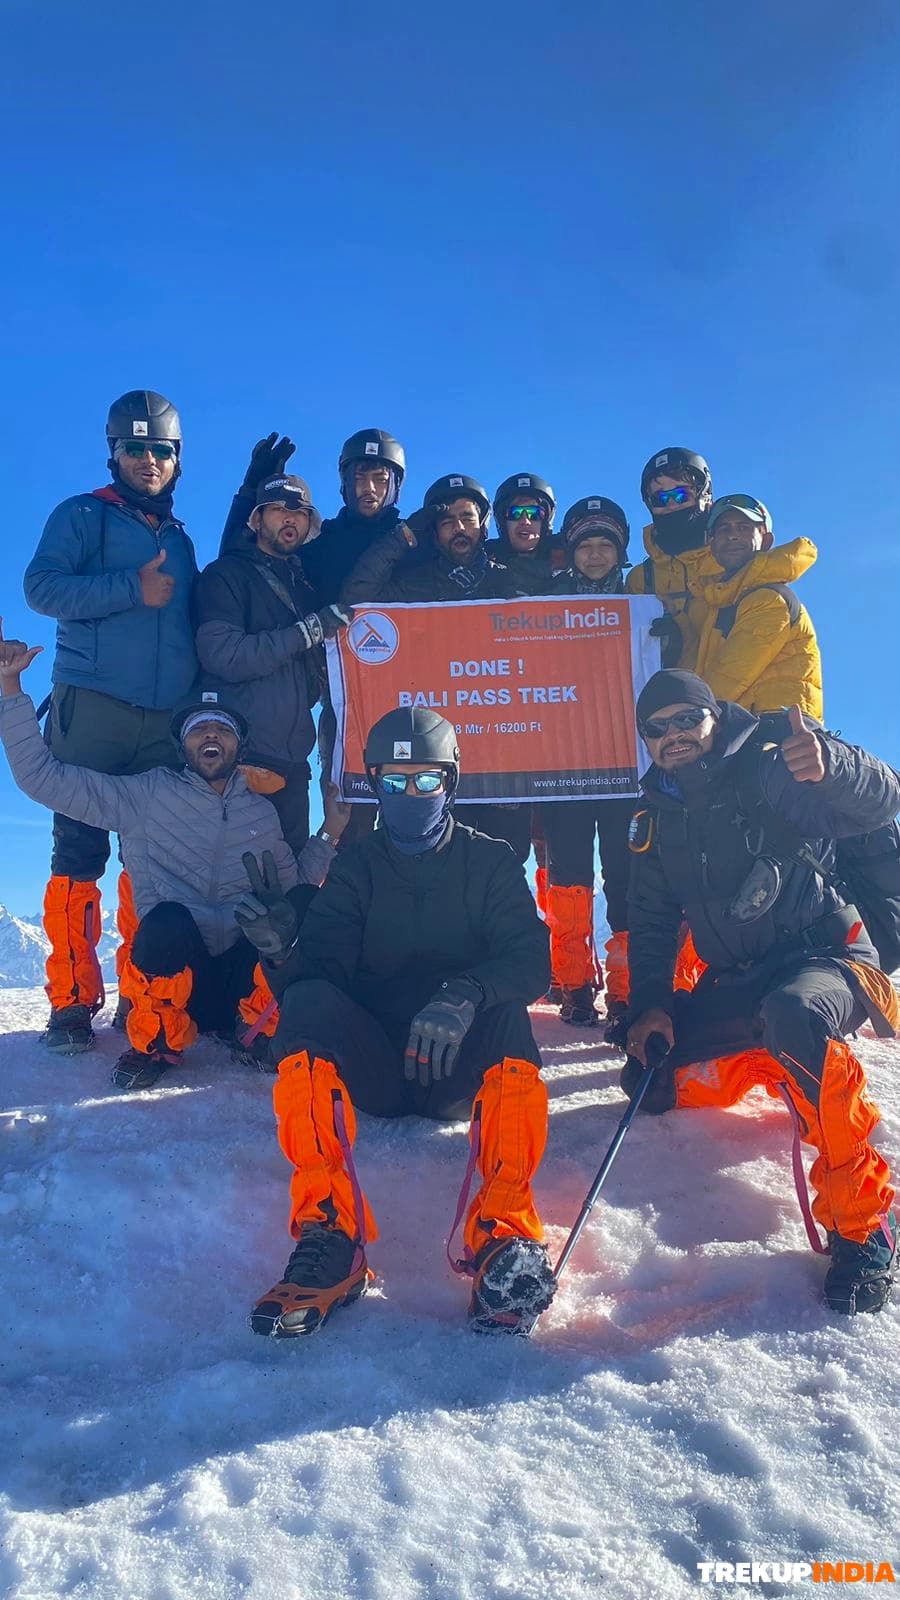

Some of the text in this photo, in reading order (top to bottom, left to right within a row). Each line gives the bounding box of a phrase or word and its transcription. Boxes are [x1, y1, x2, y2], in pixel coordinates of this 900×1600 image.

[488, 606, 620, 632] TrekupIndia
[450, 659, 525, 677] DONE !
[399, 685, 578, 708] BALI PASS TREK
[455, 721, 542, 734] 8 Mtr / 16200 Ft
[533, 776, 630, 788] www.trekupindia.com
